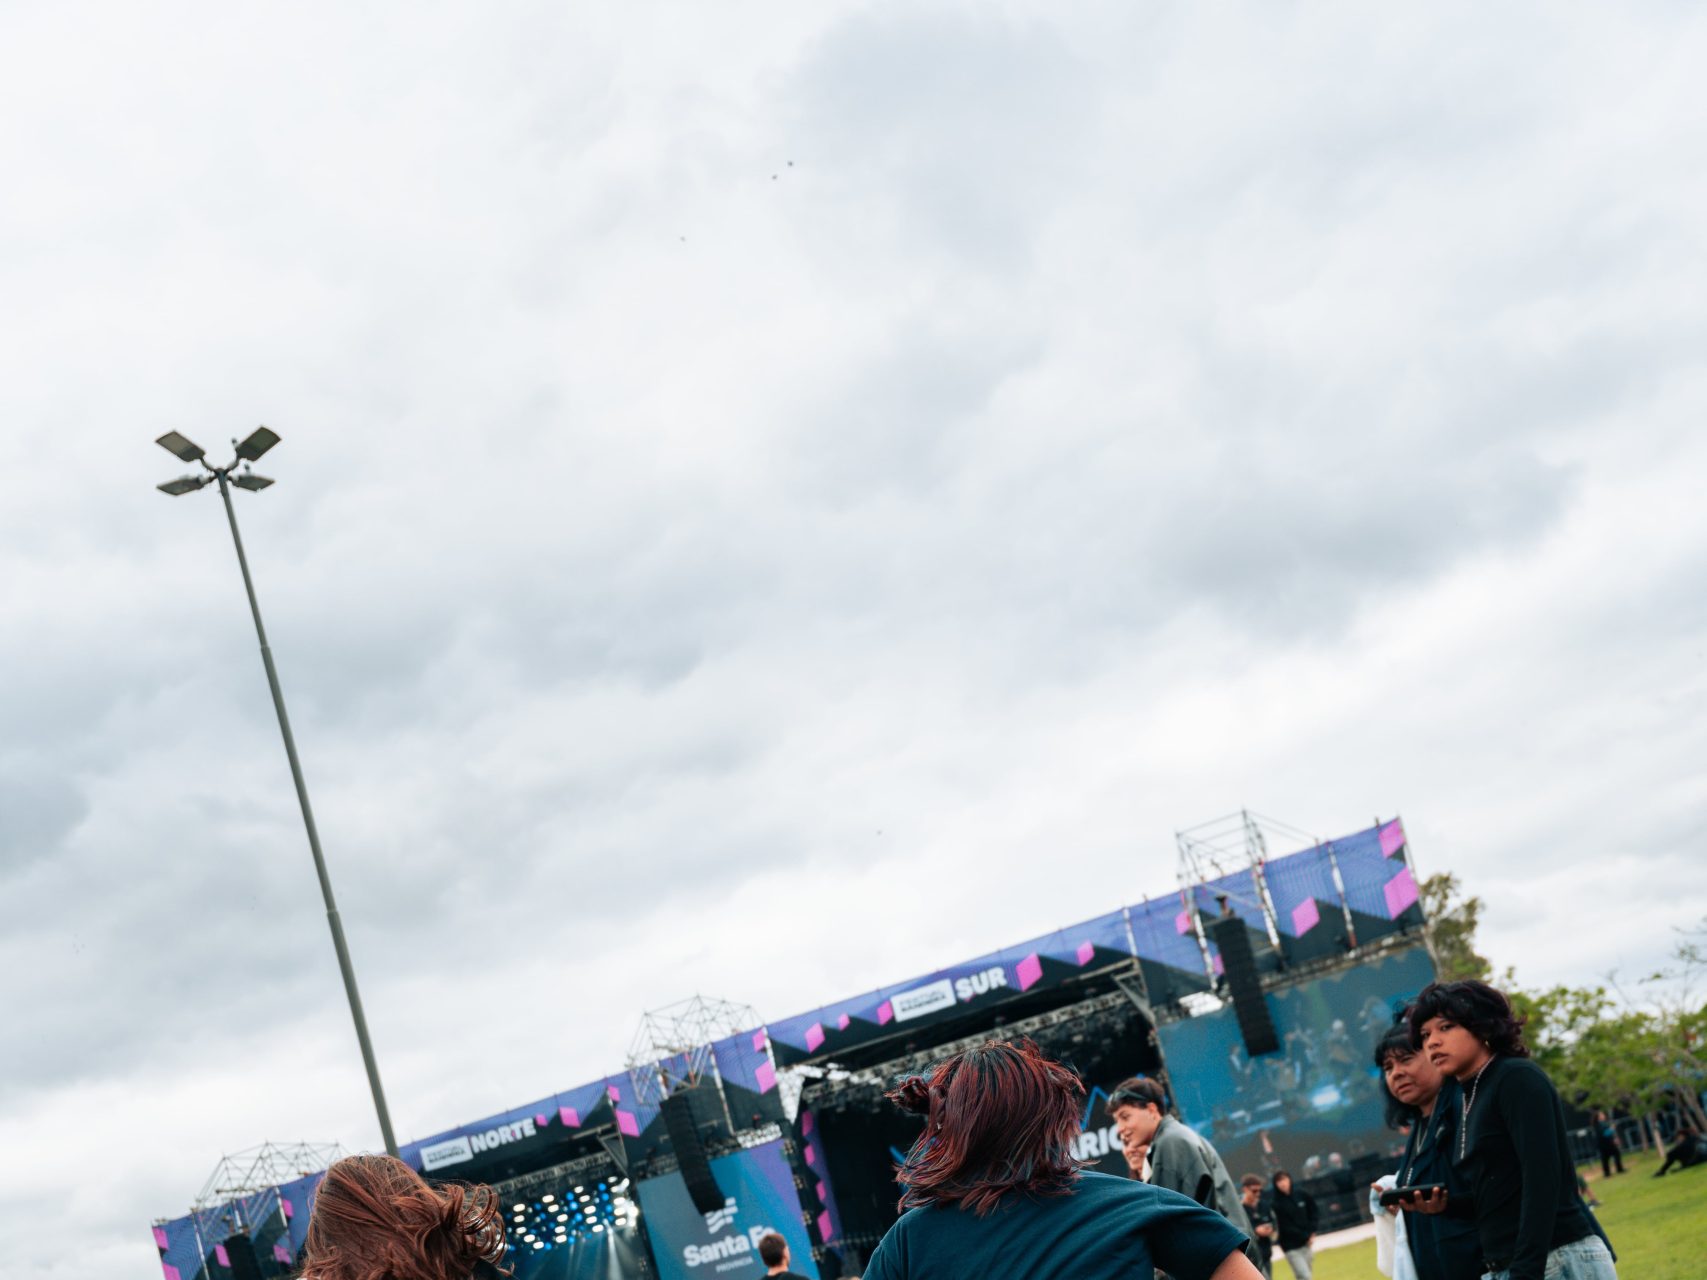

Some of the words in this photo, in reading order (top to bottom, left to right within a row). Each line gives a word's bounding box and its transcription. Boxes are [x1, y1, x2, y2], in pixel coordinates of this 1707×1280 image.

[955, 967, 1008, 999] SUR
[470, 1117, 537, 1154] NORTE
[683, 1234, 750, 1267] Santa
